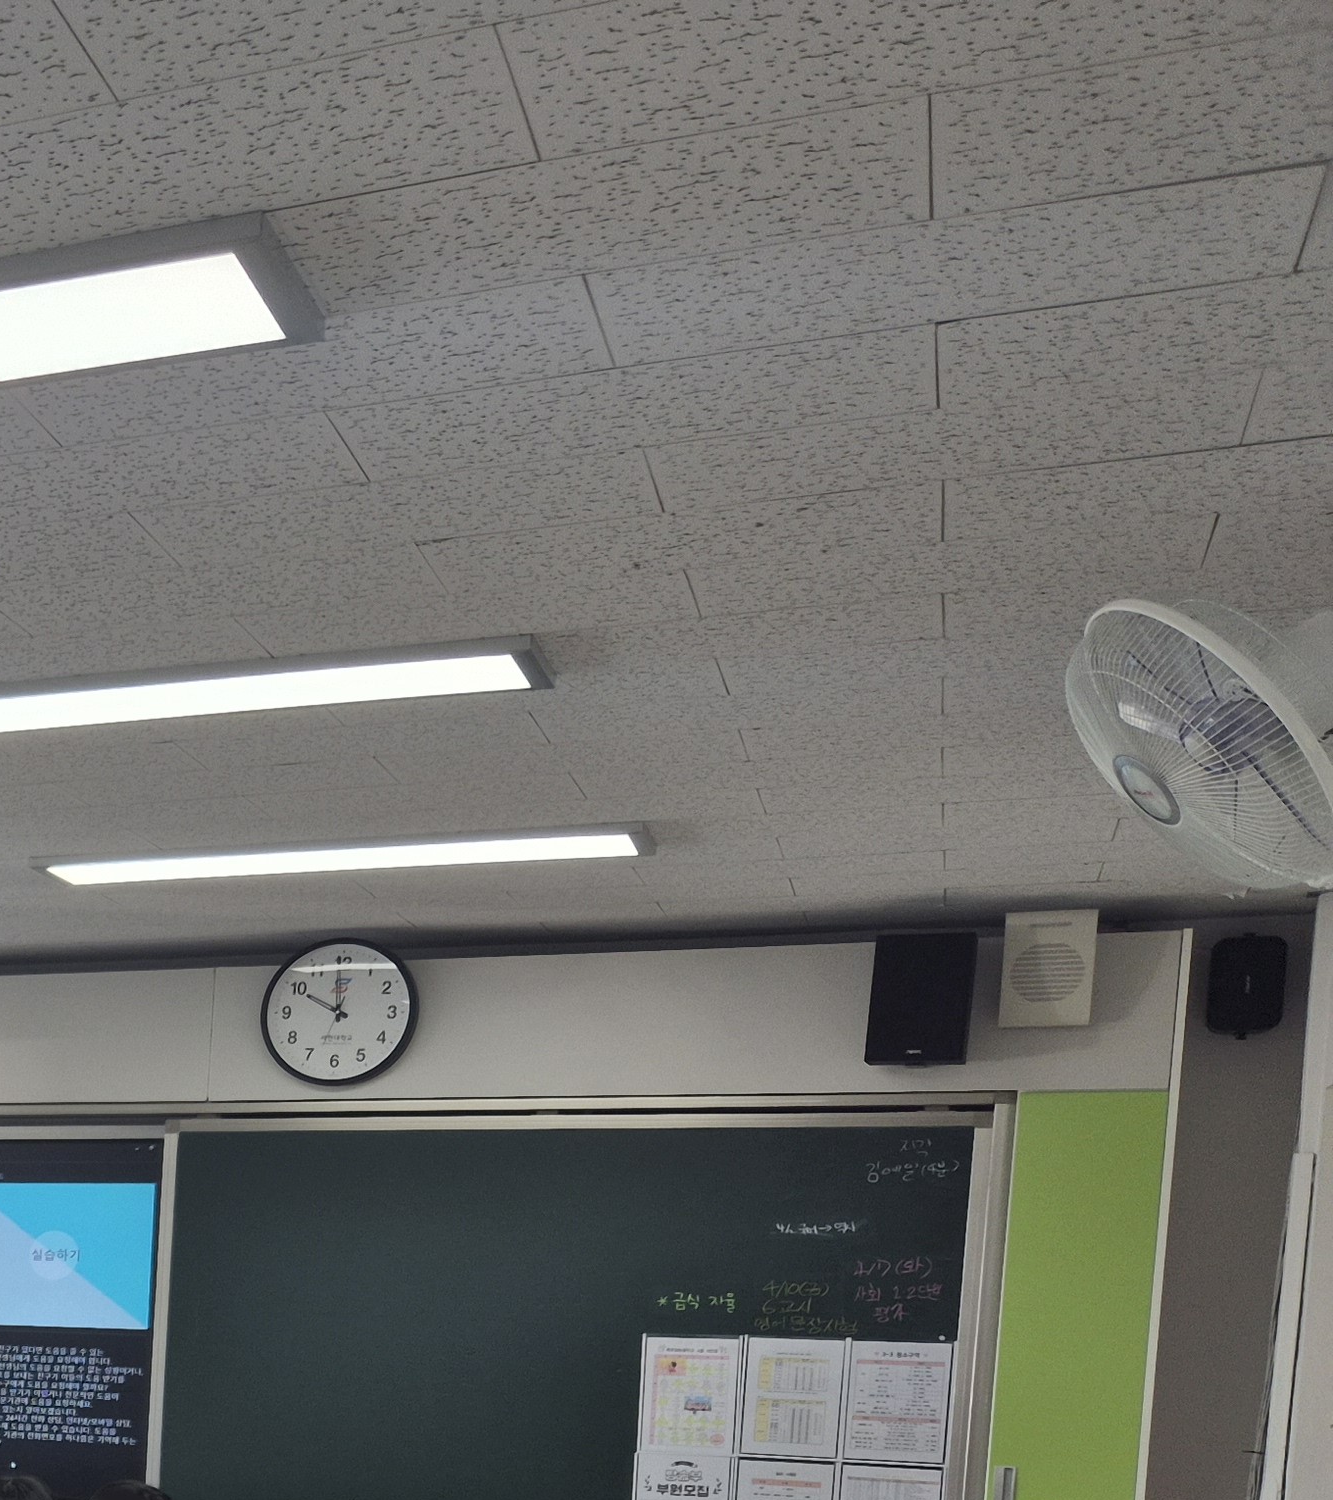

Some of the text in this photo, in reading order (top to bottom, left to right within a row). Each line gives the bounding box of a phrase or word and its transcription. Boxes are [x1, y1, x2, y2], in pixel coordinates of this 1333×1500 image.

[291, 981, 307, 996] 10
[381, 980, 392, 995] 2
[282, 1005, 292, 1020] 9
[386, 1005, 397, 1019] 3
[287, 1030, 298, 1044] 8
[376, 1030, 386, 1045] 4
[305, 1047, 315, 1061] 7
[329, 1054, 340, 1068] 6
[356, 1048, 366, 1063] 5
[32, 1248, 80, 1262] 실습하기
[673, 1292, 700, 1311] 급식
[656, 1483, 710, 1498] 부원모집
